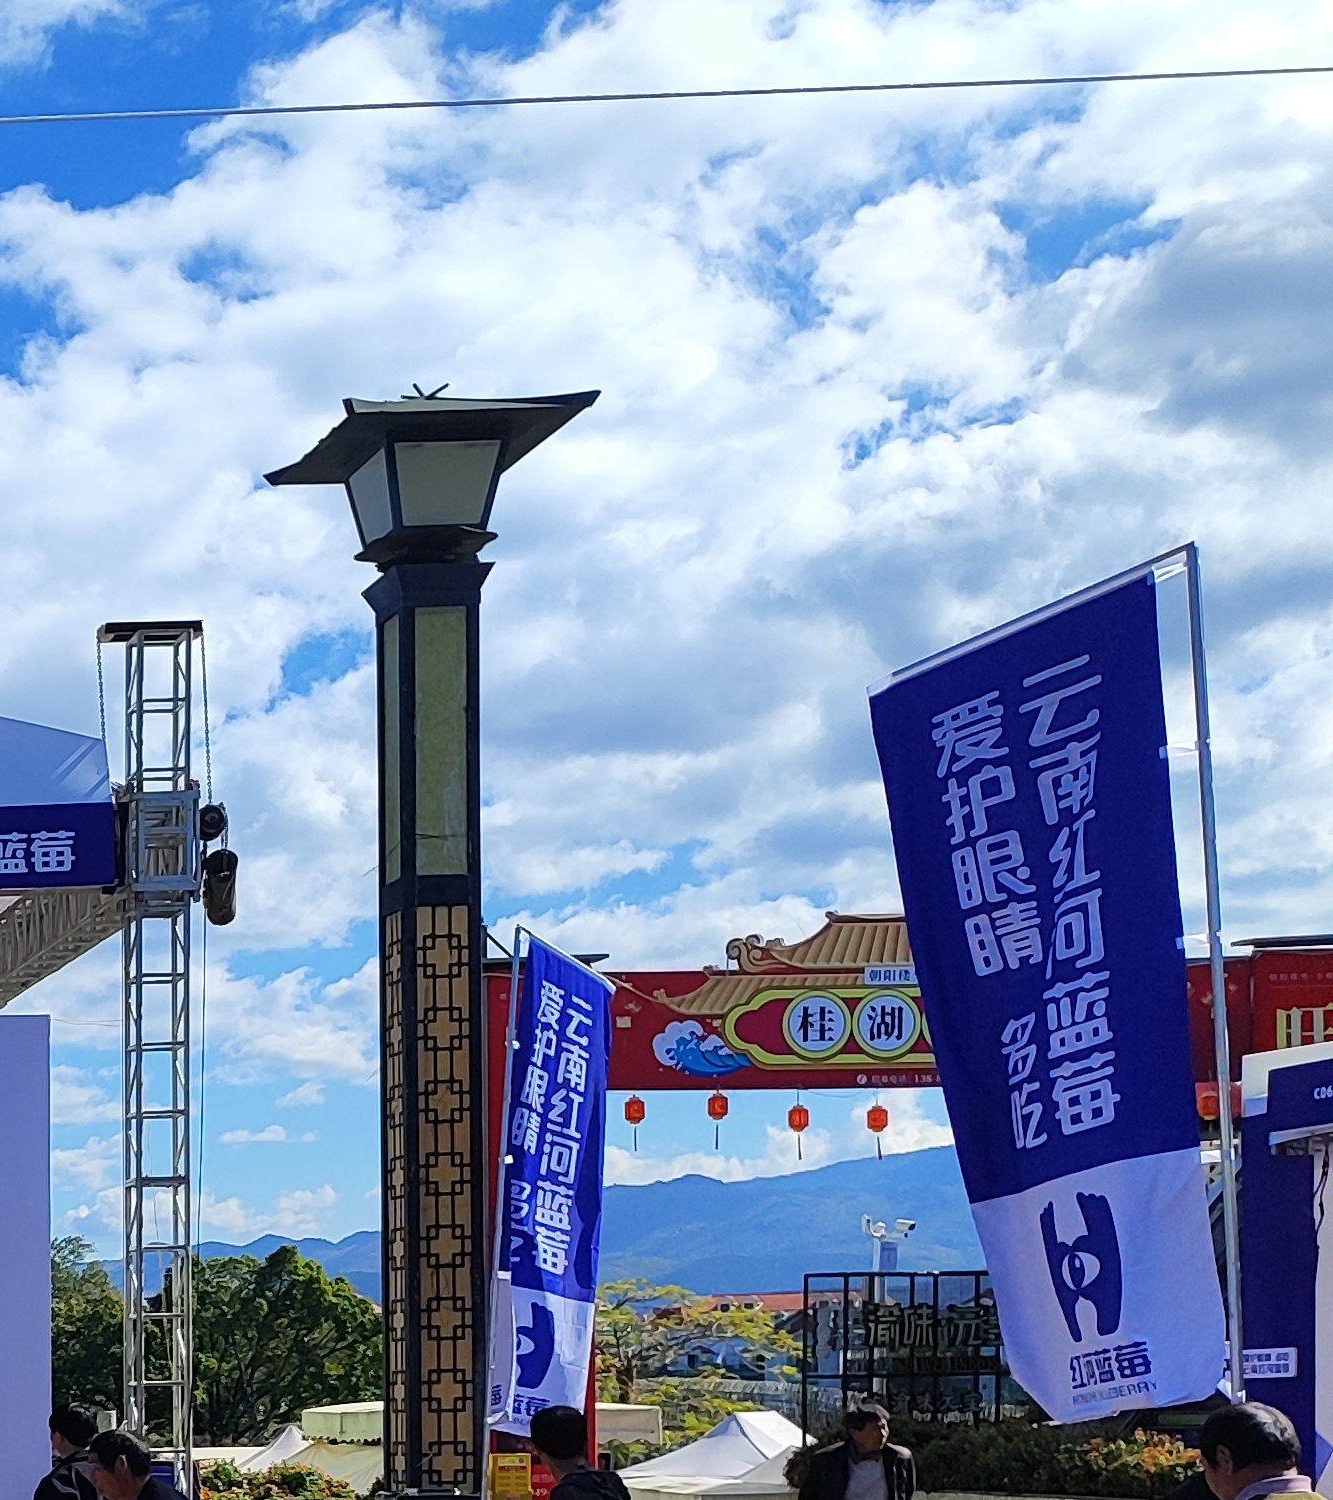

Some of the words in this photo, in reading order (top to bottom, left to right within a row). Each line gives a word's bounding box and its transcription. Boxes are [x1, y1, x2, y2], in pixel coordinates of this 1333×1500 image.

[796, 1005, 905, 1043] 桂湖
[932, 690, 1044, 977] 爱护眼睛
[1000, 1011, 1048, 1149] 多吃
[1019, 653, 1121, 1136] 云南红河蓝莓
[511, 978, 565, 1155] 爱护眼睛
[531, 994, 593, 1276] 云南红河蓝莓
